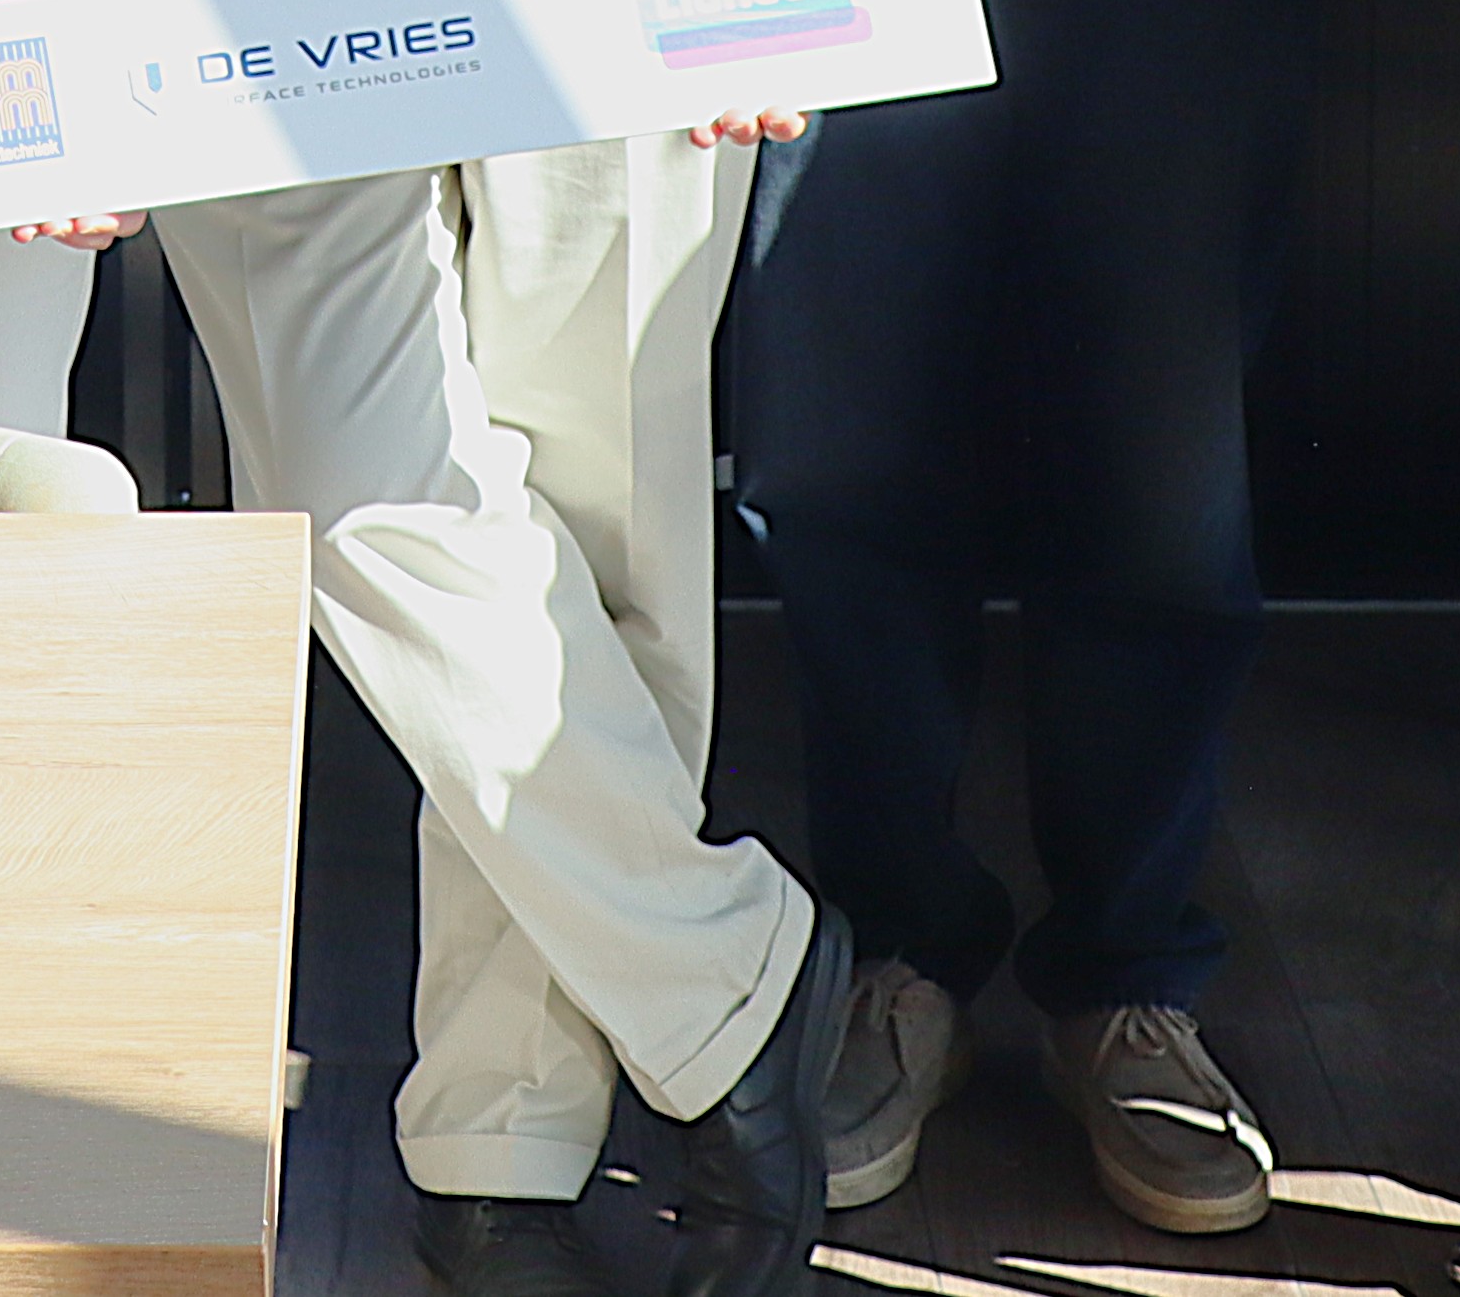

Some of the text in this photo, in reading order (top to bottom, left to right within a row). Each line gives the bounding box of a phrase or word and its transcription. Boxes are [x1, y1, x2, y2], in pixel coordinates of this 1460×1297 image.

[197, 15, 478, 84] DE VRIES
[225, 58, 483, 107] RFACE TECHNOLOGIES
